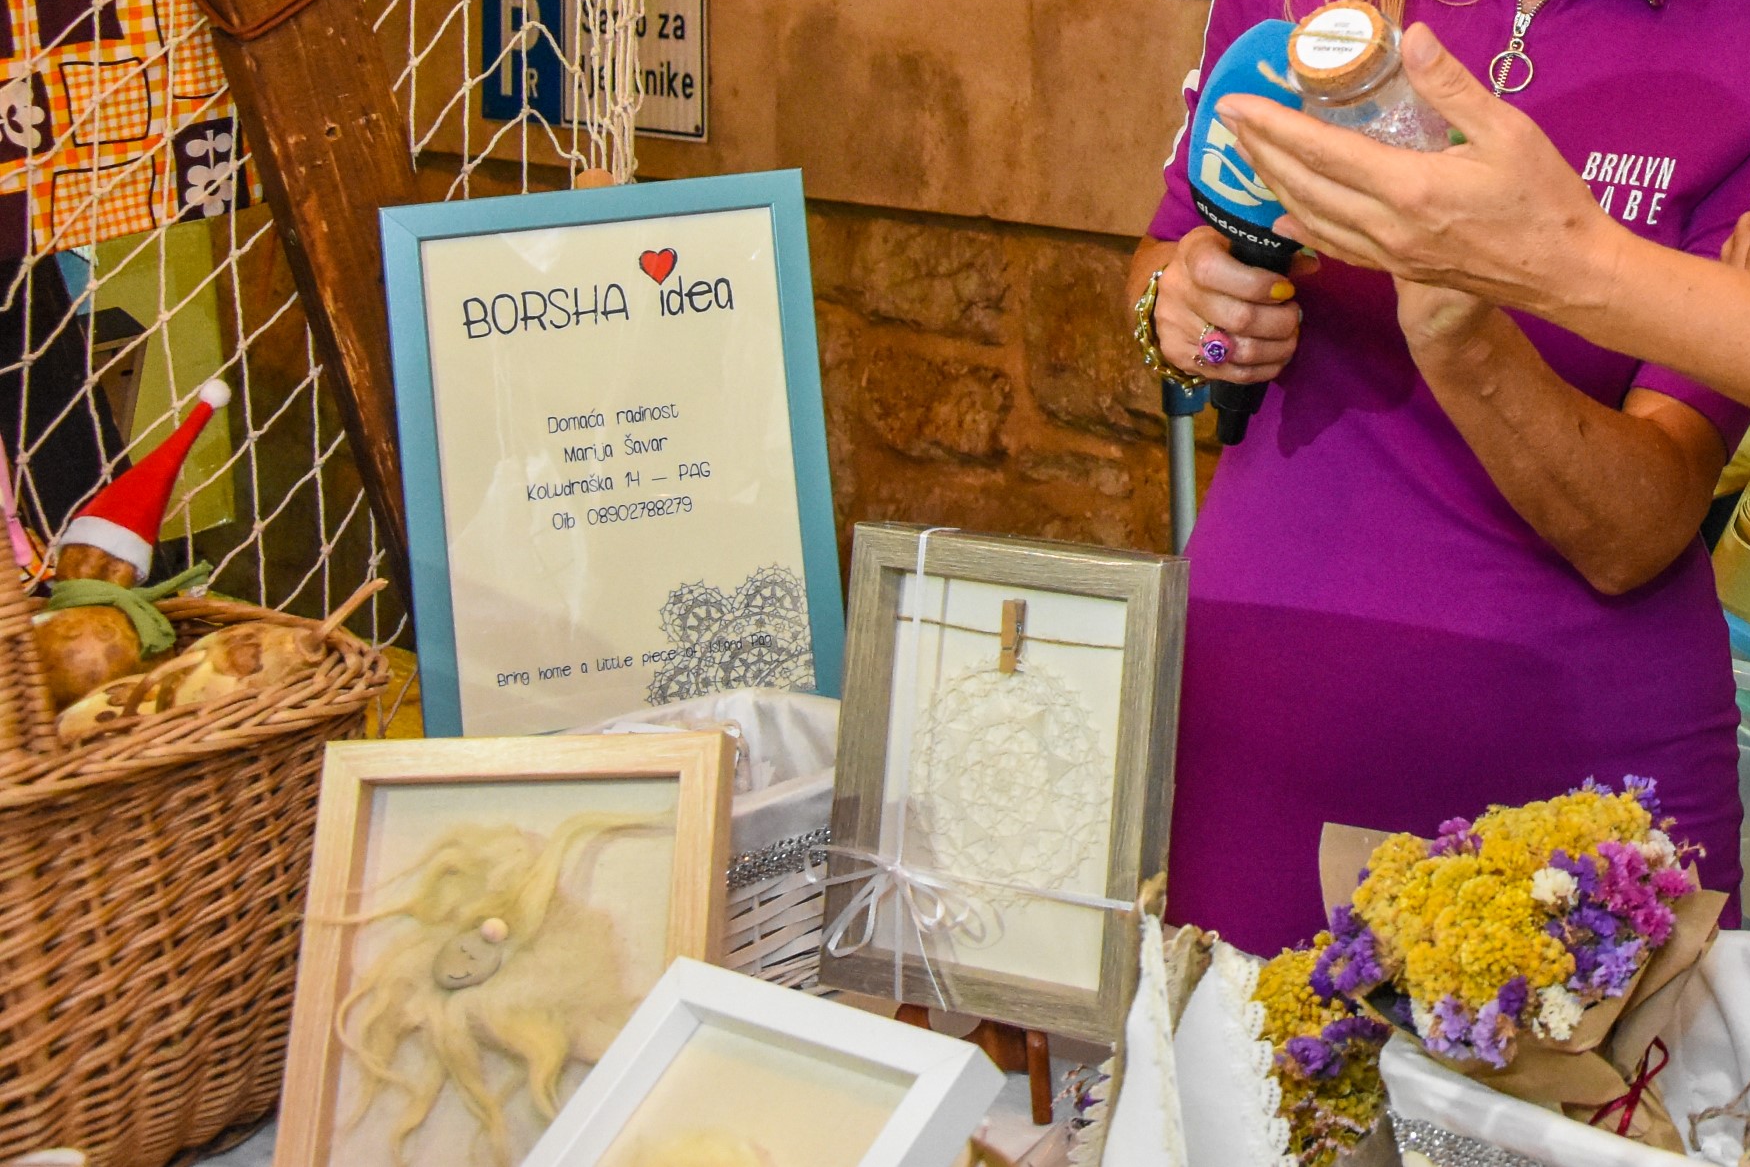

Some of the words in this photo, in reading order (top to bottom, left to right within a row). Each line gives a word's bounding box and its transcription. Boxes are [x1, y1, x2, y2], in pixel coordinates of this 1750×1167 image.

[658, 12, 686, 39] za
[526, 69, 539, 98] R
[1581, 151, 1677, 190] BRKLYN
[1586, 184, 1667, 225] ABE
[1196, 200, 1281, 249] diadora.tv
[462, 283, 630, 339] BORSHA
[659, 275, 734, 317] idea
[547, 408, 605, 434] Domaća
[616, 403, 679, 425] radinost
[564, 443, 613, 463] Marija
[624, 434, 668, 456] Šavar
[526, 473, 614, 501] Koludraška
[625, 470, 640, 488] 14
[678, 461, 711, 481] PAG
[552, 512, 576, 531] Oib
[587, 495, 693, 526] 08902788279
[497, 670, 529, 686] Bring
[538, 663, 571, 680] home
[580, 661, 588, 674] a
[642, 647, 677, 667] piece
